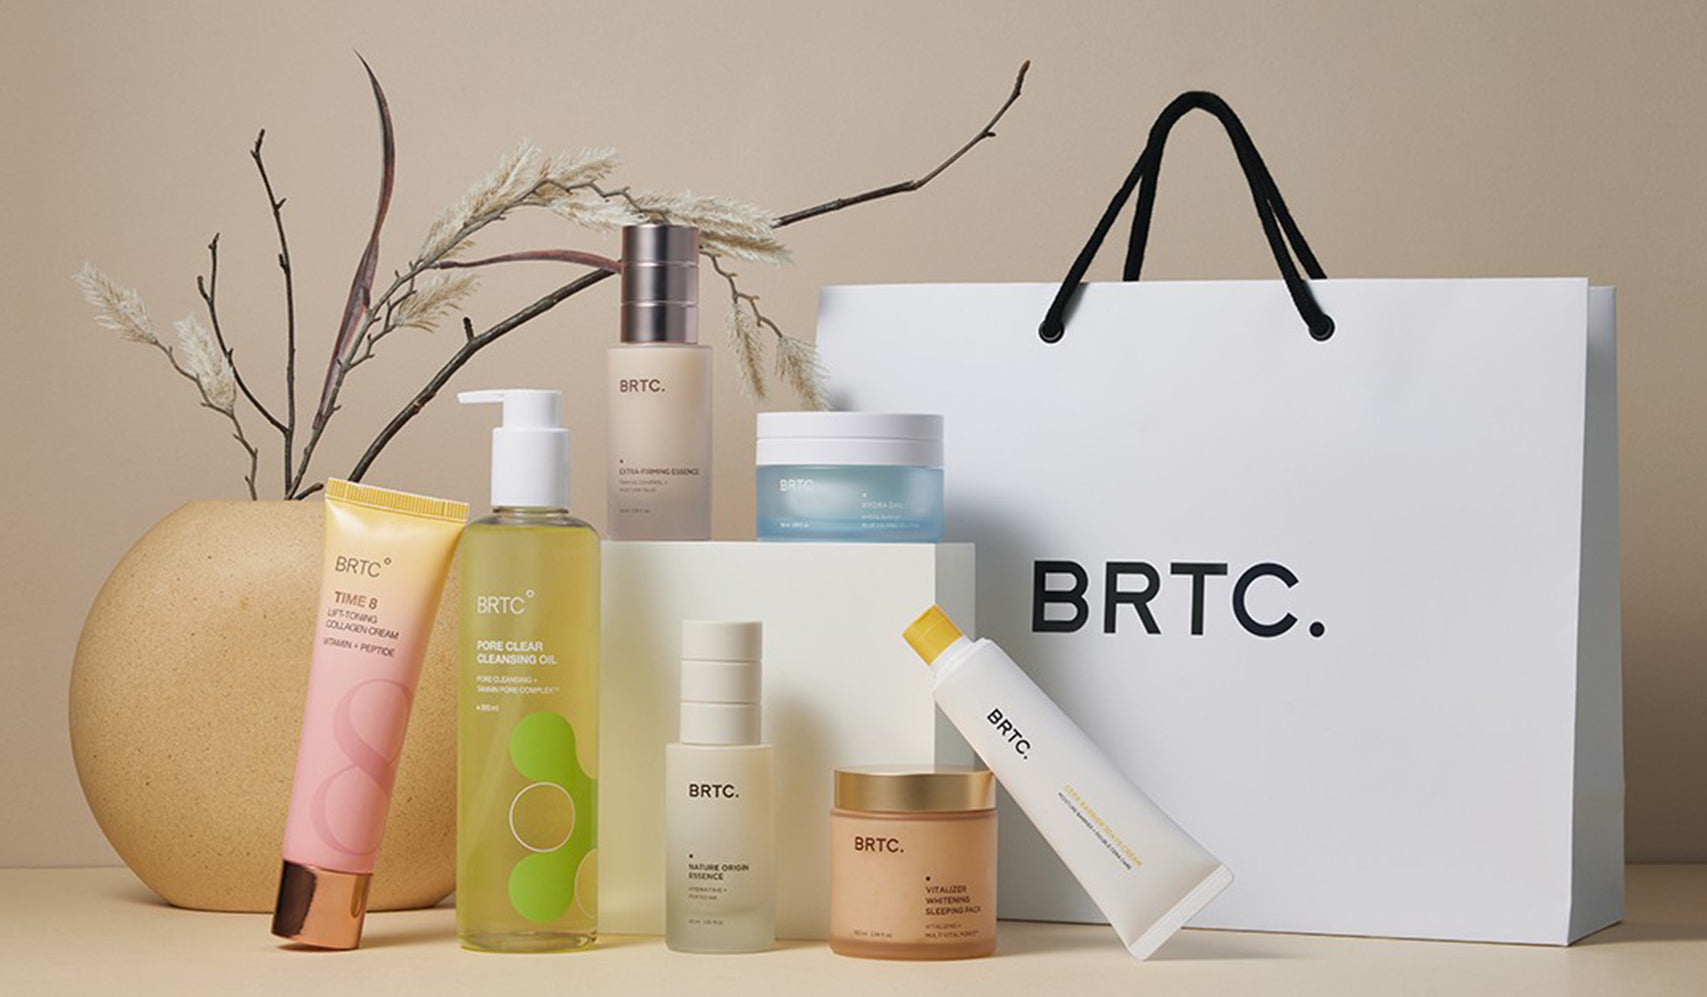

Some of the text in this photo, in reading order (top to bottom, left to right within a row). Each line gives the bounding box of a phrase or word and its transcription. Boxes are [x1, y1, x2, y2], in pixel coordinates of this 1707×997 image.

[620, 379, 665, 392] BRTC.
[335, 591, 378, 610] TIME 8
[1032, 560, 1326, 638] BRTC.
[326, 619, 400, 640] COLLAGEN CREAM
[477, 640, 543, 652] PORE CLEAR
[477, 654, 557, 665] CLEANSING OIL
[987, 708, 1031, 759] BRTC.
[689, 783, 739, 798] BRTC.
[854, 836, 904, 853] BRTC.
[688, 863, 750, 872] NATURE ORIGIN
[688, 873, 724, 881] ESSENCE
[925, 896, 970, 904] WHITENING
[925, 906, 963, 916] SLEEPING
